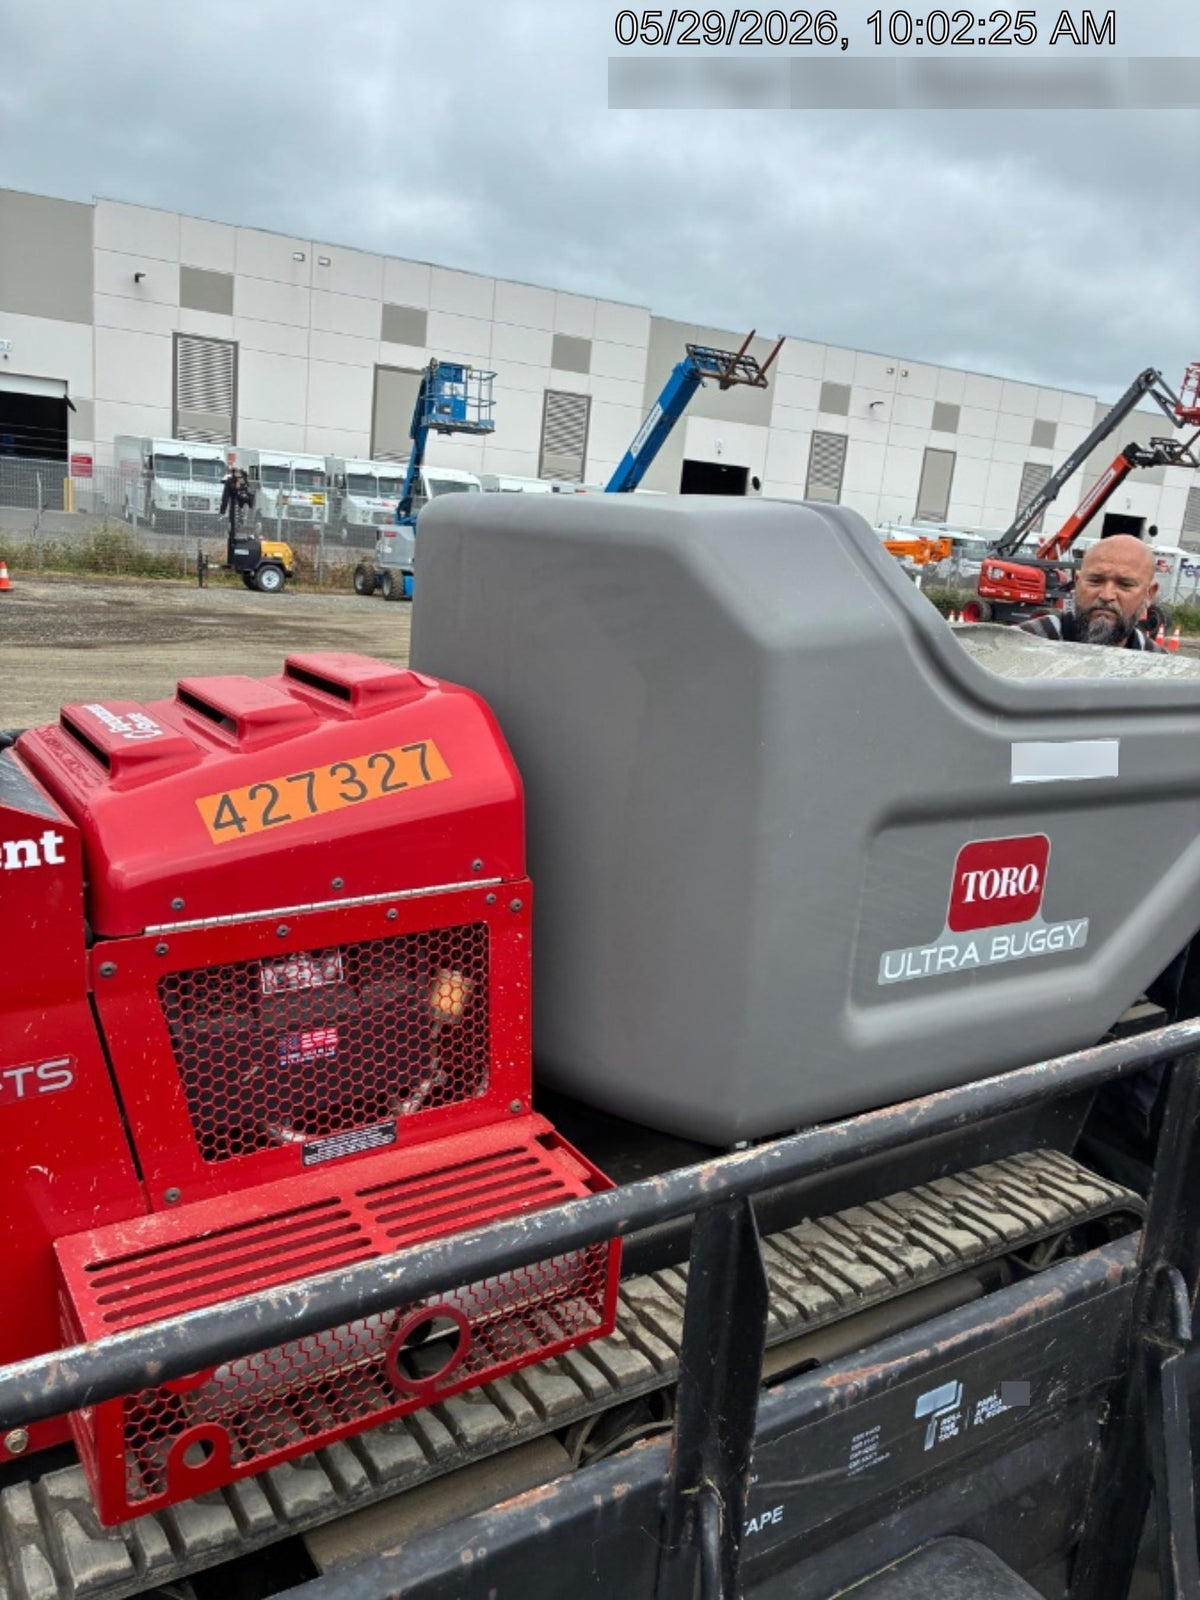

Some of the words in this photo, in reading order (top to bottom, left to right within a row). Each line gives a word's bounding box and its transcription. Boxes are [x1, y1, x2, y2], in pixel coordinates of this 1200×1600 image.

[212, 744, 436, 834] 427327
[0, 829, 66, 870] nt
[961, 862, 1040, 904] TORO
[884, 943, 981, 979] ULTRA
[990, 926, 1082, 959] BUGGY
[0, 1058, 73, 1097] TS
[743, 1504, 784, 1537] APE
